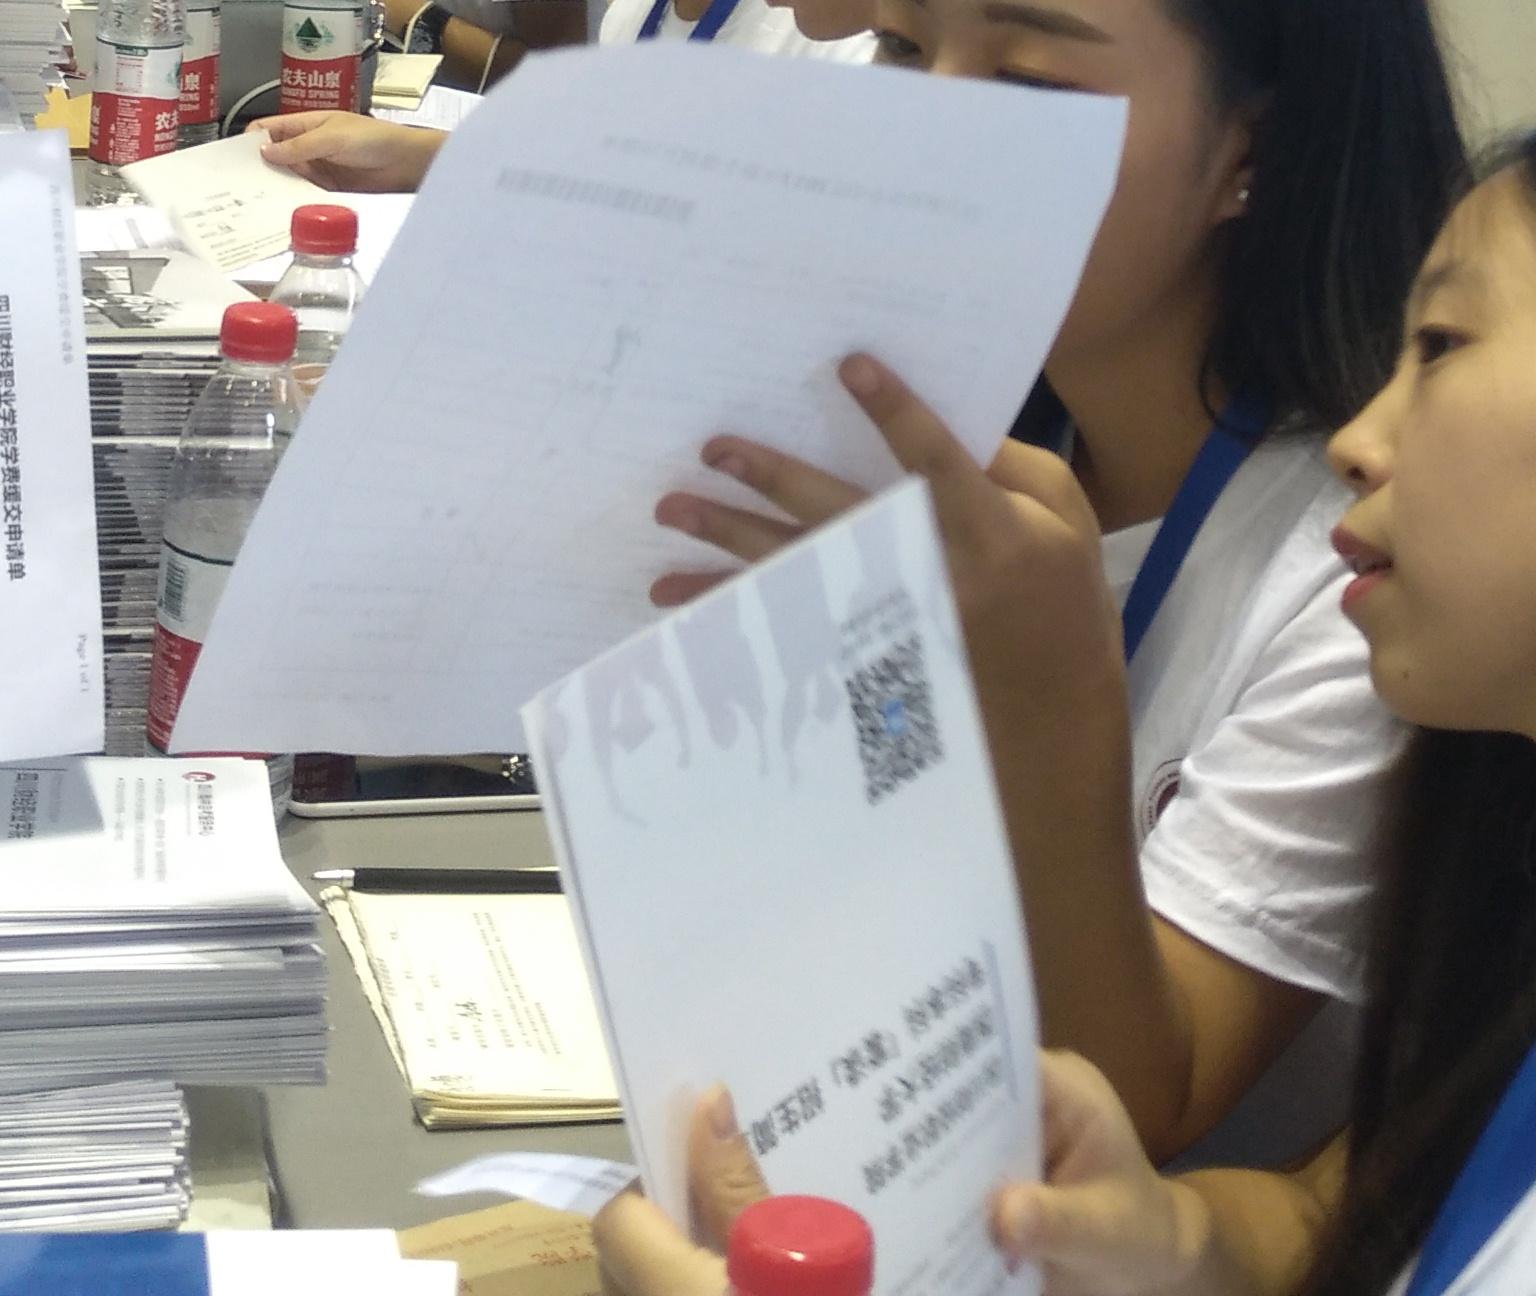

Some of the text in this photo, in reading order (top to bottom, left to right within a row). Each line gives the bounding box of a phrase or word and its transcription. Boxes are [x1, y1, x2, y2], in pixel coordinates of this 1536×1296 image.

[282, 66, 340, 89] 农夫山泉
[76, 633, 89, 660] Page
